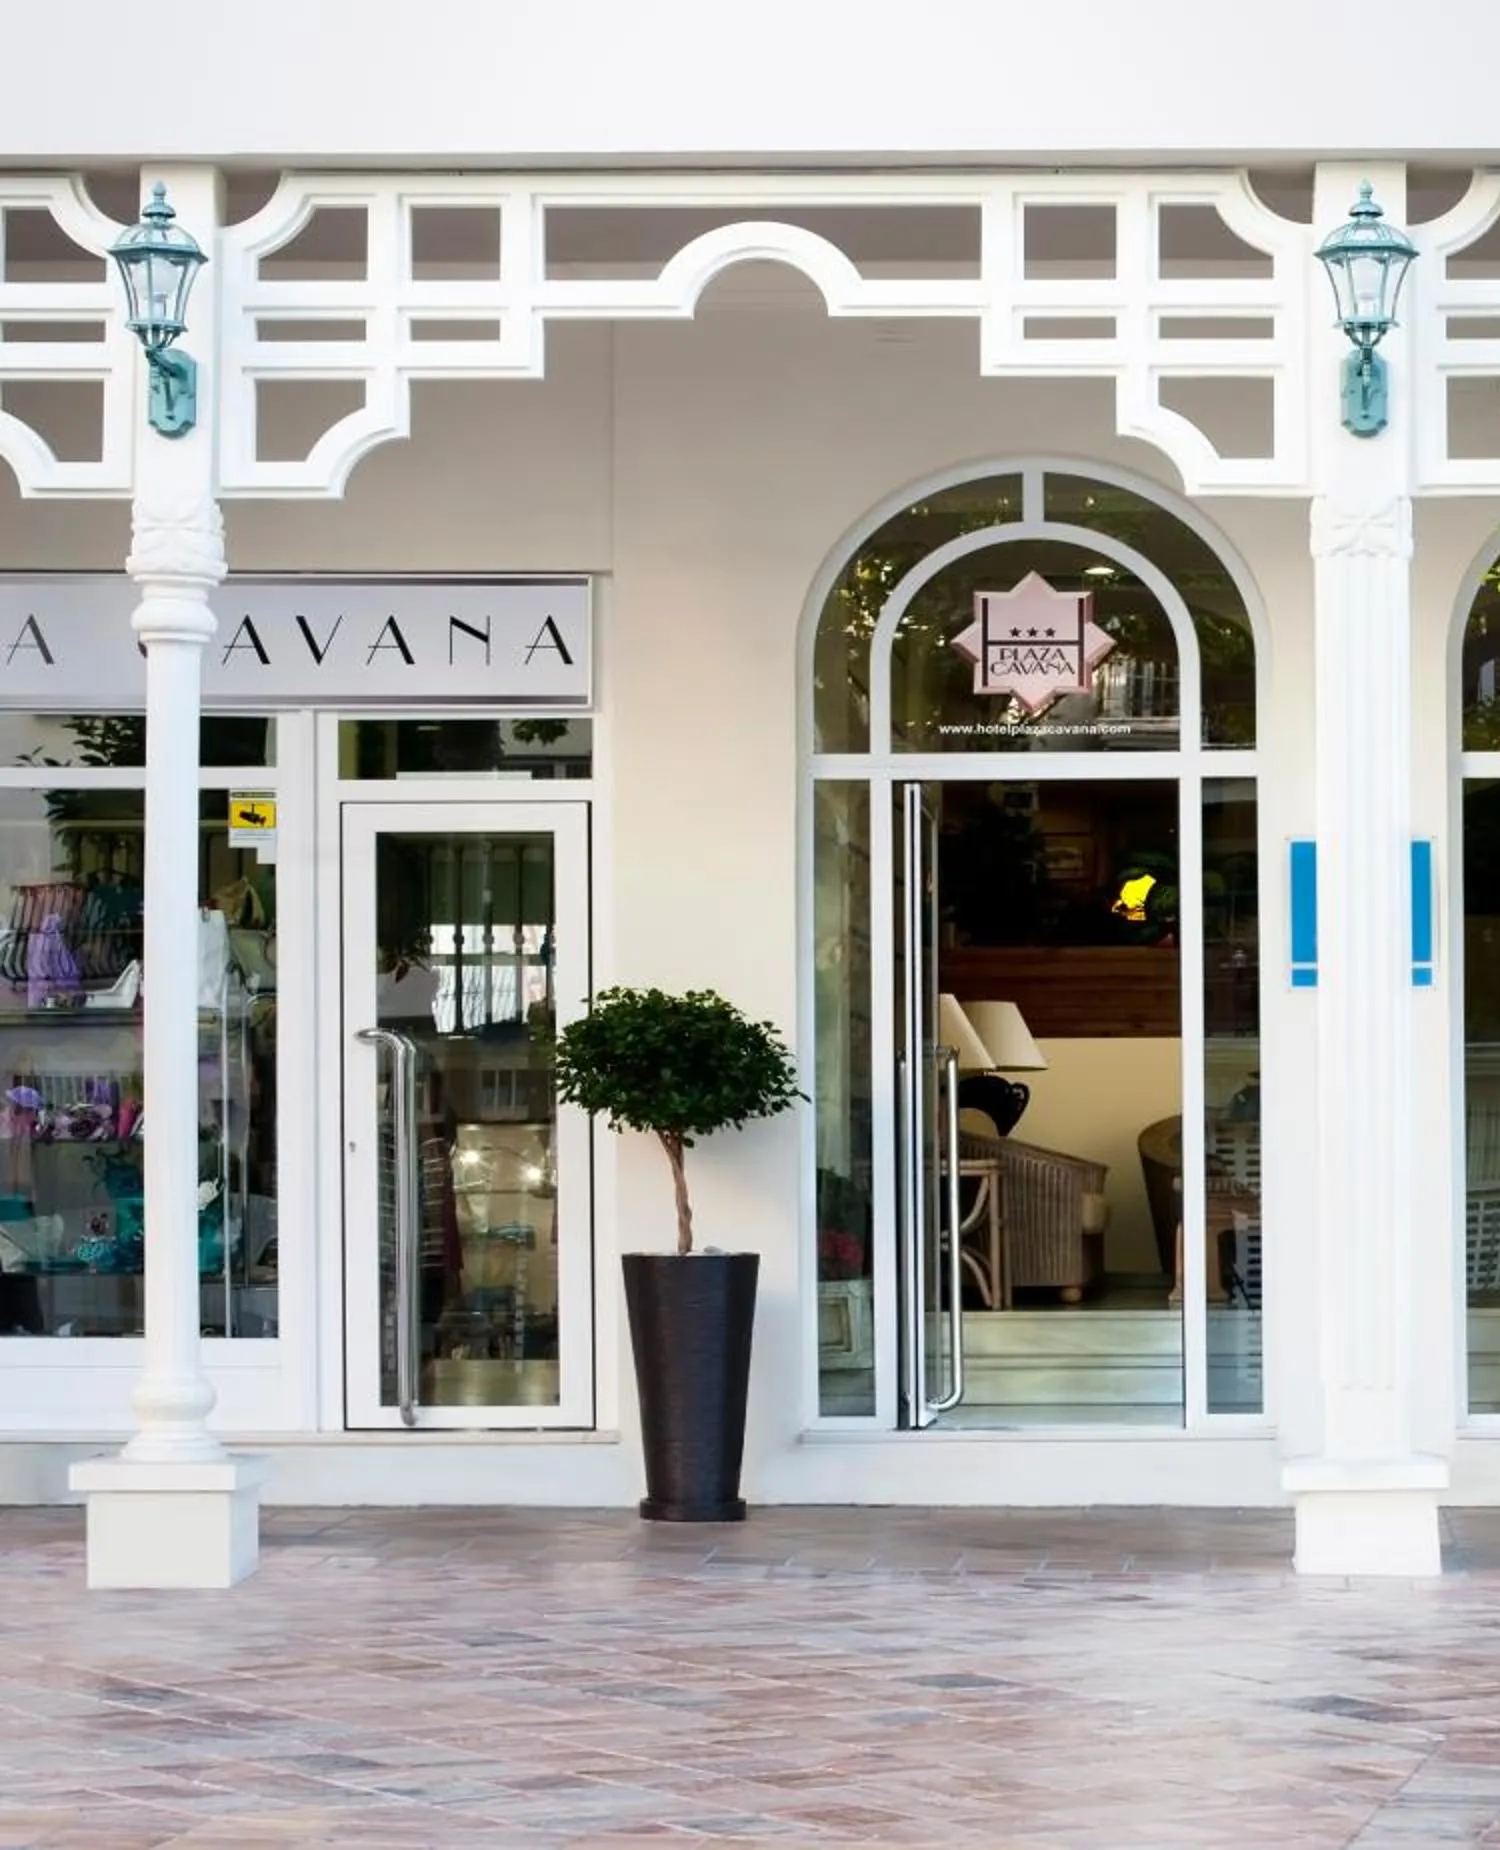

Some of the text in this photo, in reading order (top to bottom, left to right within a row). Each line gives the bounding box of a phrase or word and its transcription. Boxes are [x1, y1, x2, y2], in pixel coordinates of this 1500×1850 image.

[138, 613, 575, 666] AVANA
[999, 647, 1067, 661] PLAZA
[989, 661, 1076, 676] CAVANA
[938, 722, 1132, 737] www.hotelplazacavana.com
